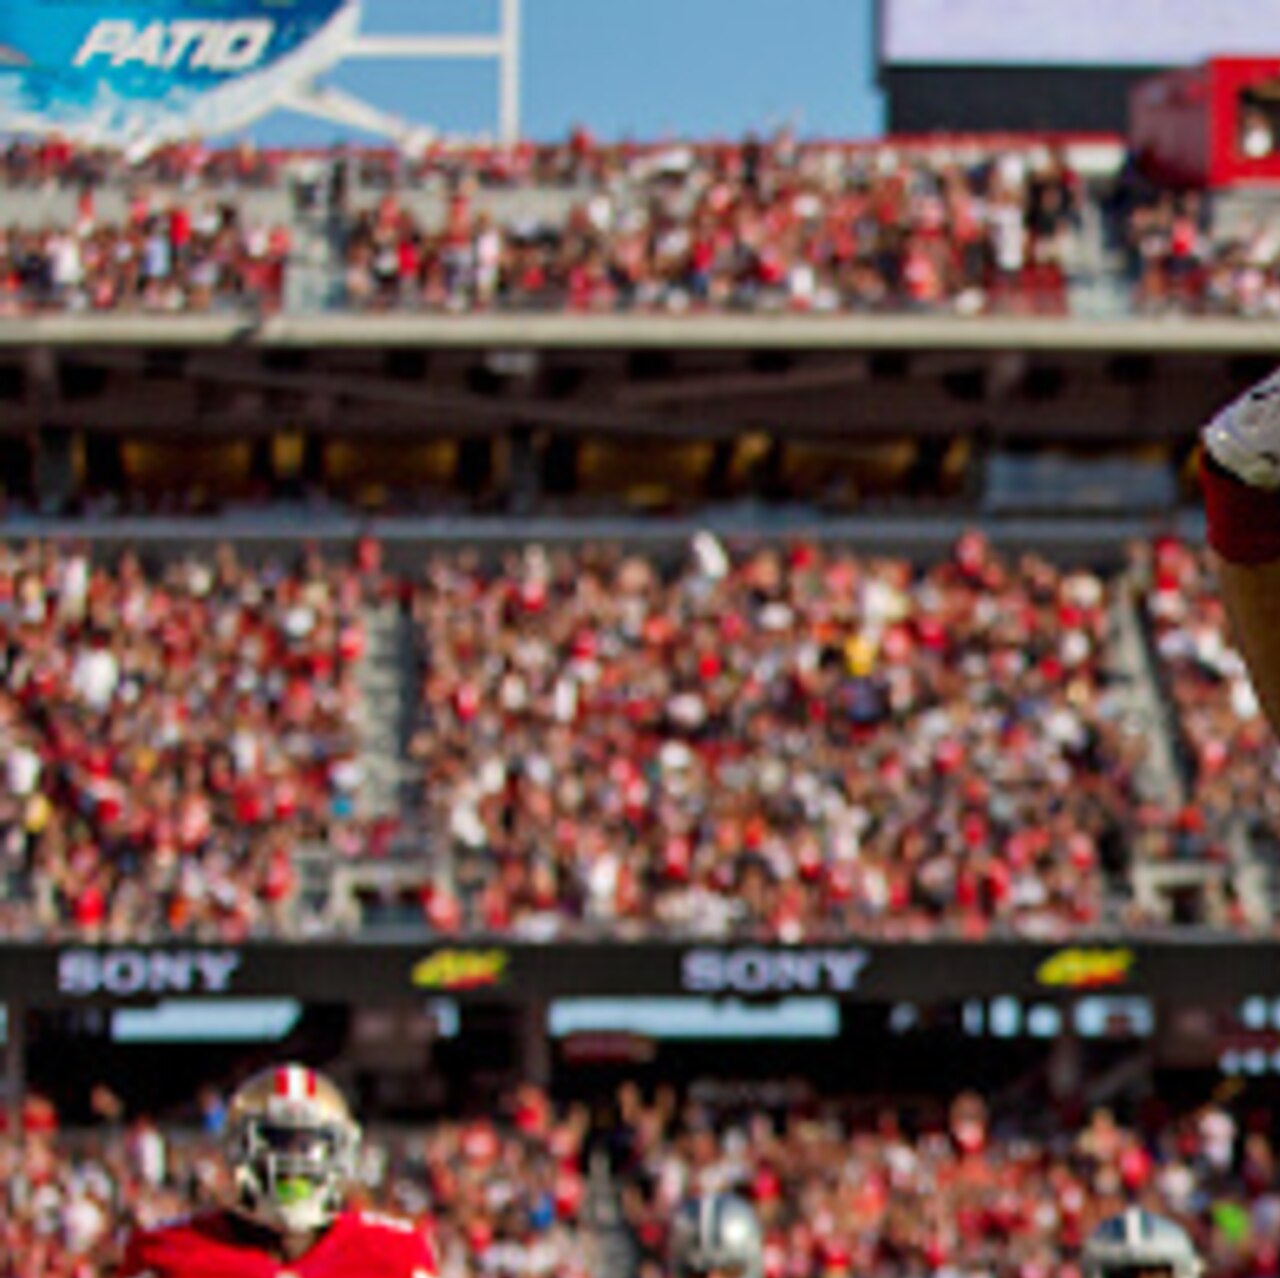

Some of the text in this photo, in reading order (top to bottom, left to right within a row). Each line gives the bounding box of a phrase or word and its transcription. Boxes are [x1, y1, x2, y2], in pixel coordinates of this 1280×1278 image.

[73, 19, 274, 71] PATIO
[58, 951, 239, 992] SONY
[682, 950, 866, 992] SONY
